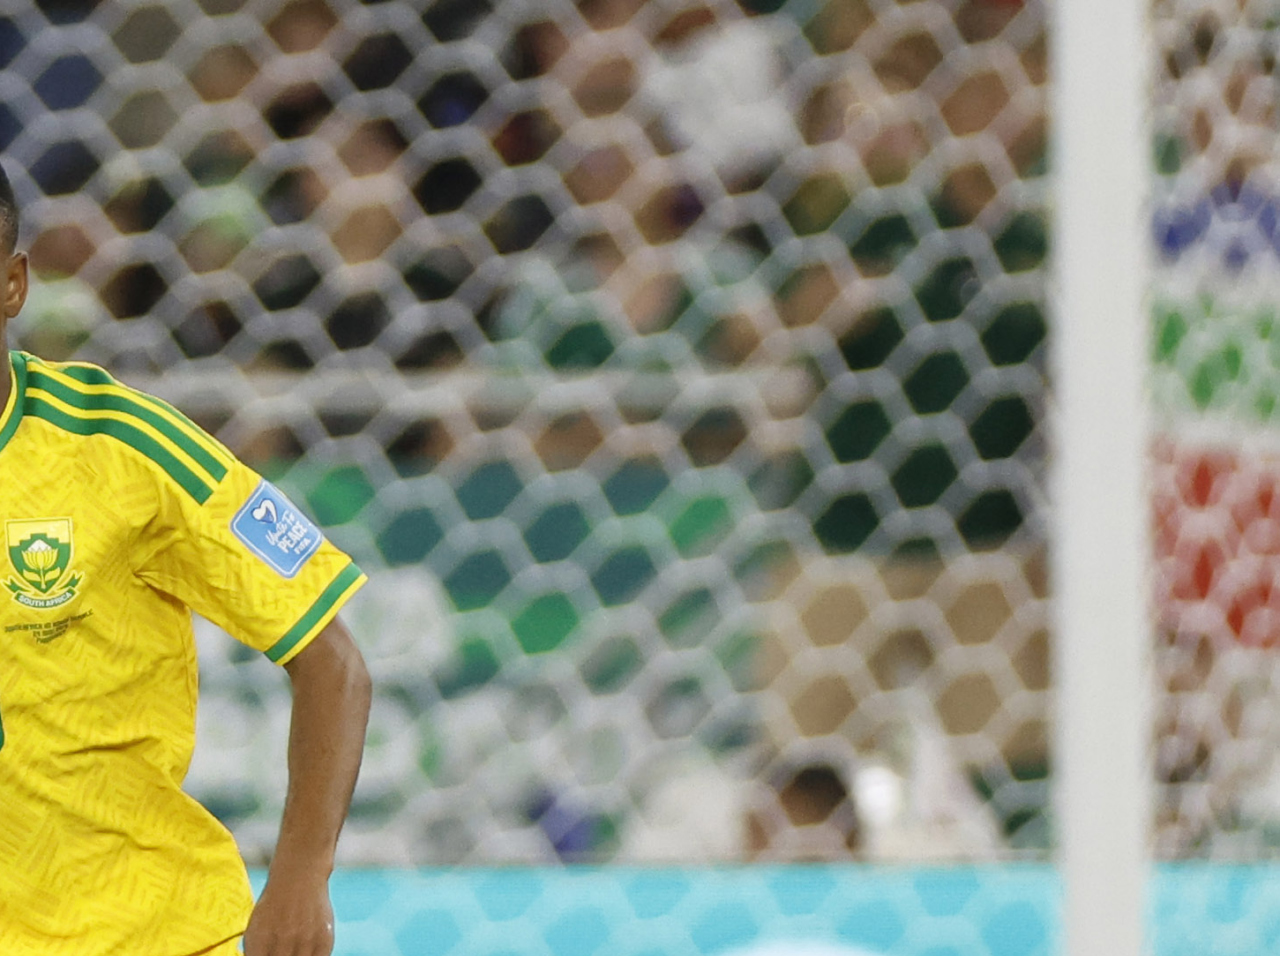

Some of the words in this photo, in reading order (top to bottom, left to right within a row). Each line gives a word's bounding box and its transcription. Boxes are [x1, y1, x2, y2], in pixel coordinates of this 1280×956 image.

[277, 521, 308, 554] PEACE
[293, 538, 312, 555] FIFA
[18, 595, 45, 607] SOUTH
[45, 591, 73, 607] AFRICA
